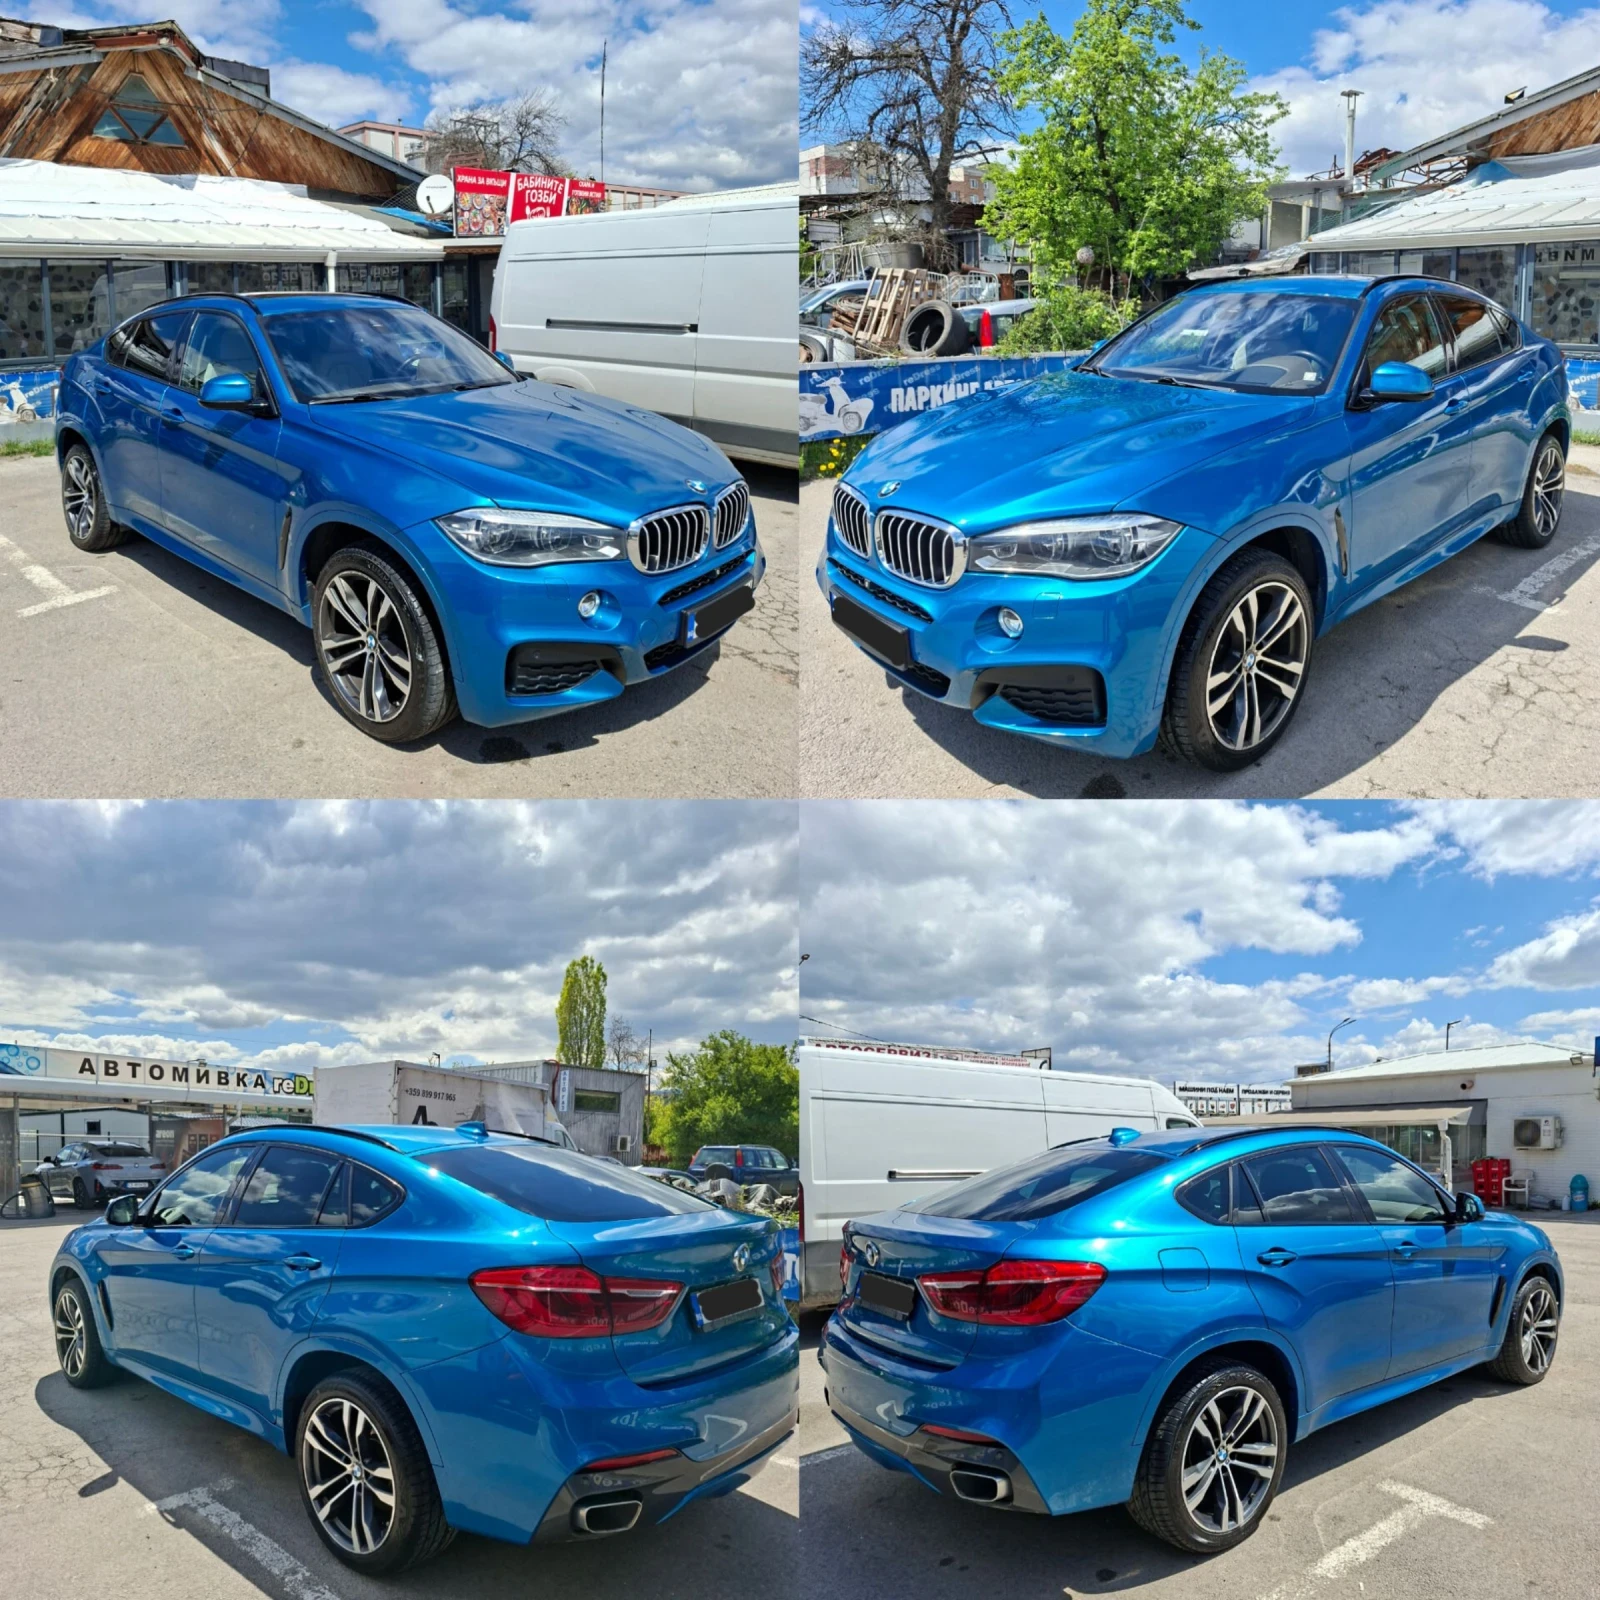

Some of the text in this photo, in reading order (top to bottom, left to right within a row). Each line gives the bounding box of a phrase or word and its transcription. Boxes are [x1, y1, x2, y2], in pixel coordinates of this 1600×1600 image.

[457, 175, 507, 188] ХРАНА ЗА ВКЪЩИ
[517, 176, 564, 194] БАБИНИТЕ
[525, 189, 557, 205] ГОЗБИ
[902, 364, 941, 386] reDress
[891, 381, 980, 413] ПАРКИНГ
[78, 1057, 266, 1089] АВТОМИВКА
[405, 1088, 421, 1096] +359
[433, 1092, 445, 1100] 917
[1178, 1086, 1206, 1094] МАШИНИ
